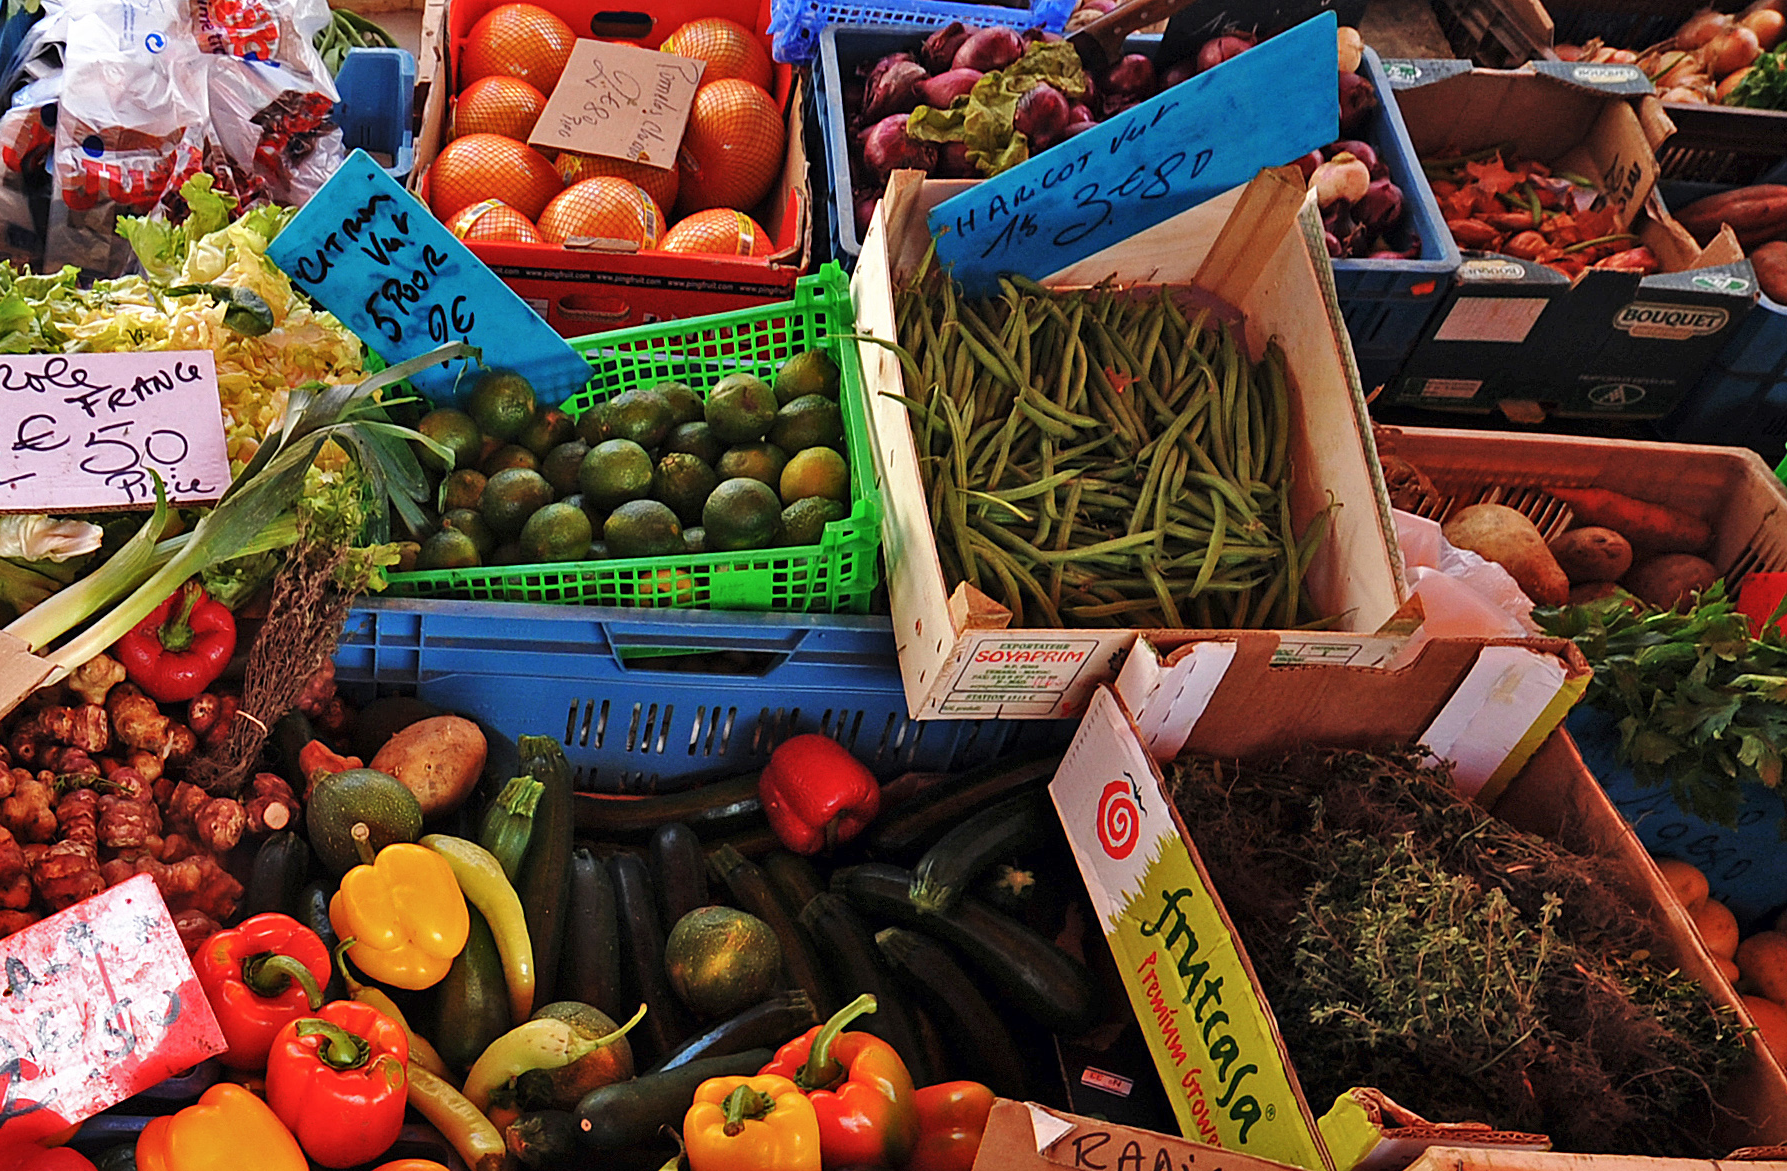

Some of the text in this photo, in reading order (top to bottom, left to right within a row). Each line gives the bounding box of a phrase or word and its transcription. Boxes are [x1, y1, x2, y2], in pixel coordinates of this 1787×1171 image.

[525, 268, 591, 281] www.pingfruit.com
[596, 273, 662, 287] www.pingfruit.com
[667, 279, 734, 293] www.pingfruit.com
[1622, 307, 1725, 329] BOUQUET
[974, 650, 1085, 664] SOYAPRIM
[999, 642, 1071, 651] EXPORTATEUR
[1180, 1069, 1223, 1148] Growe
